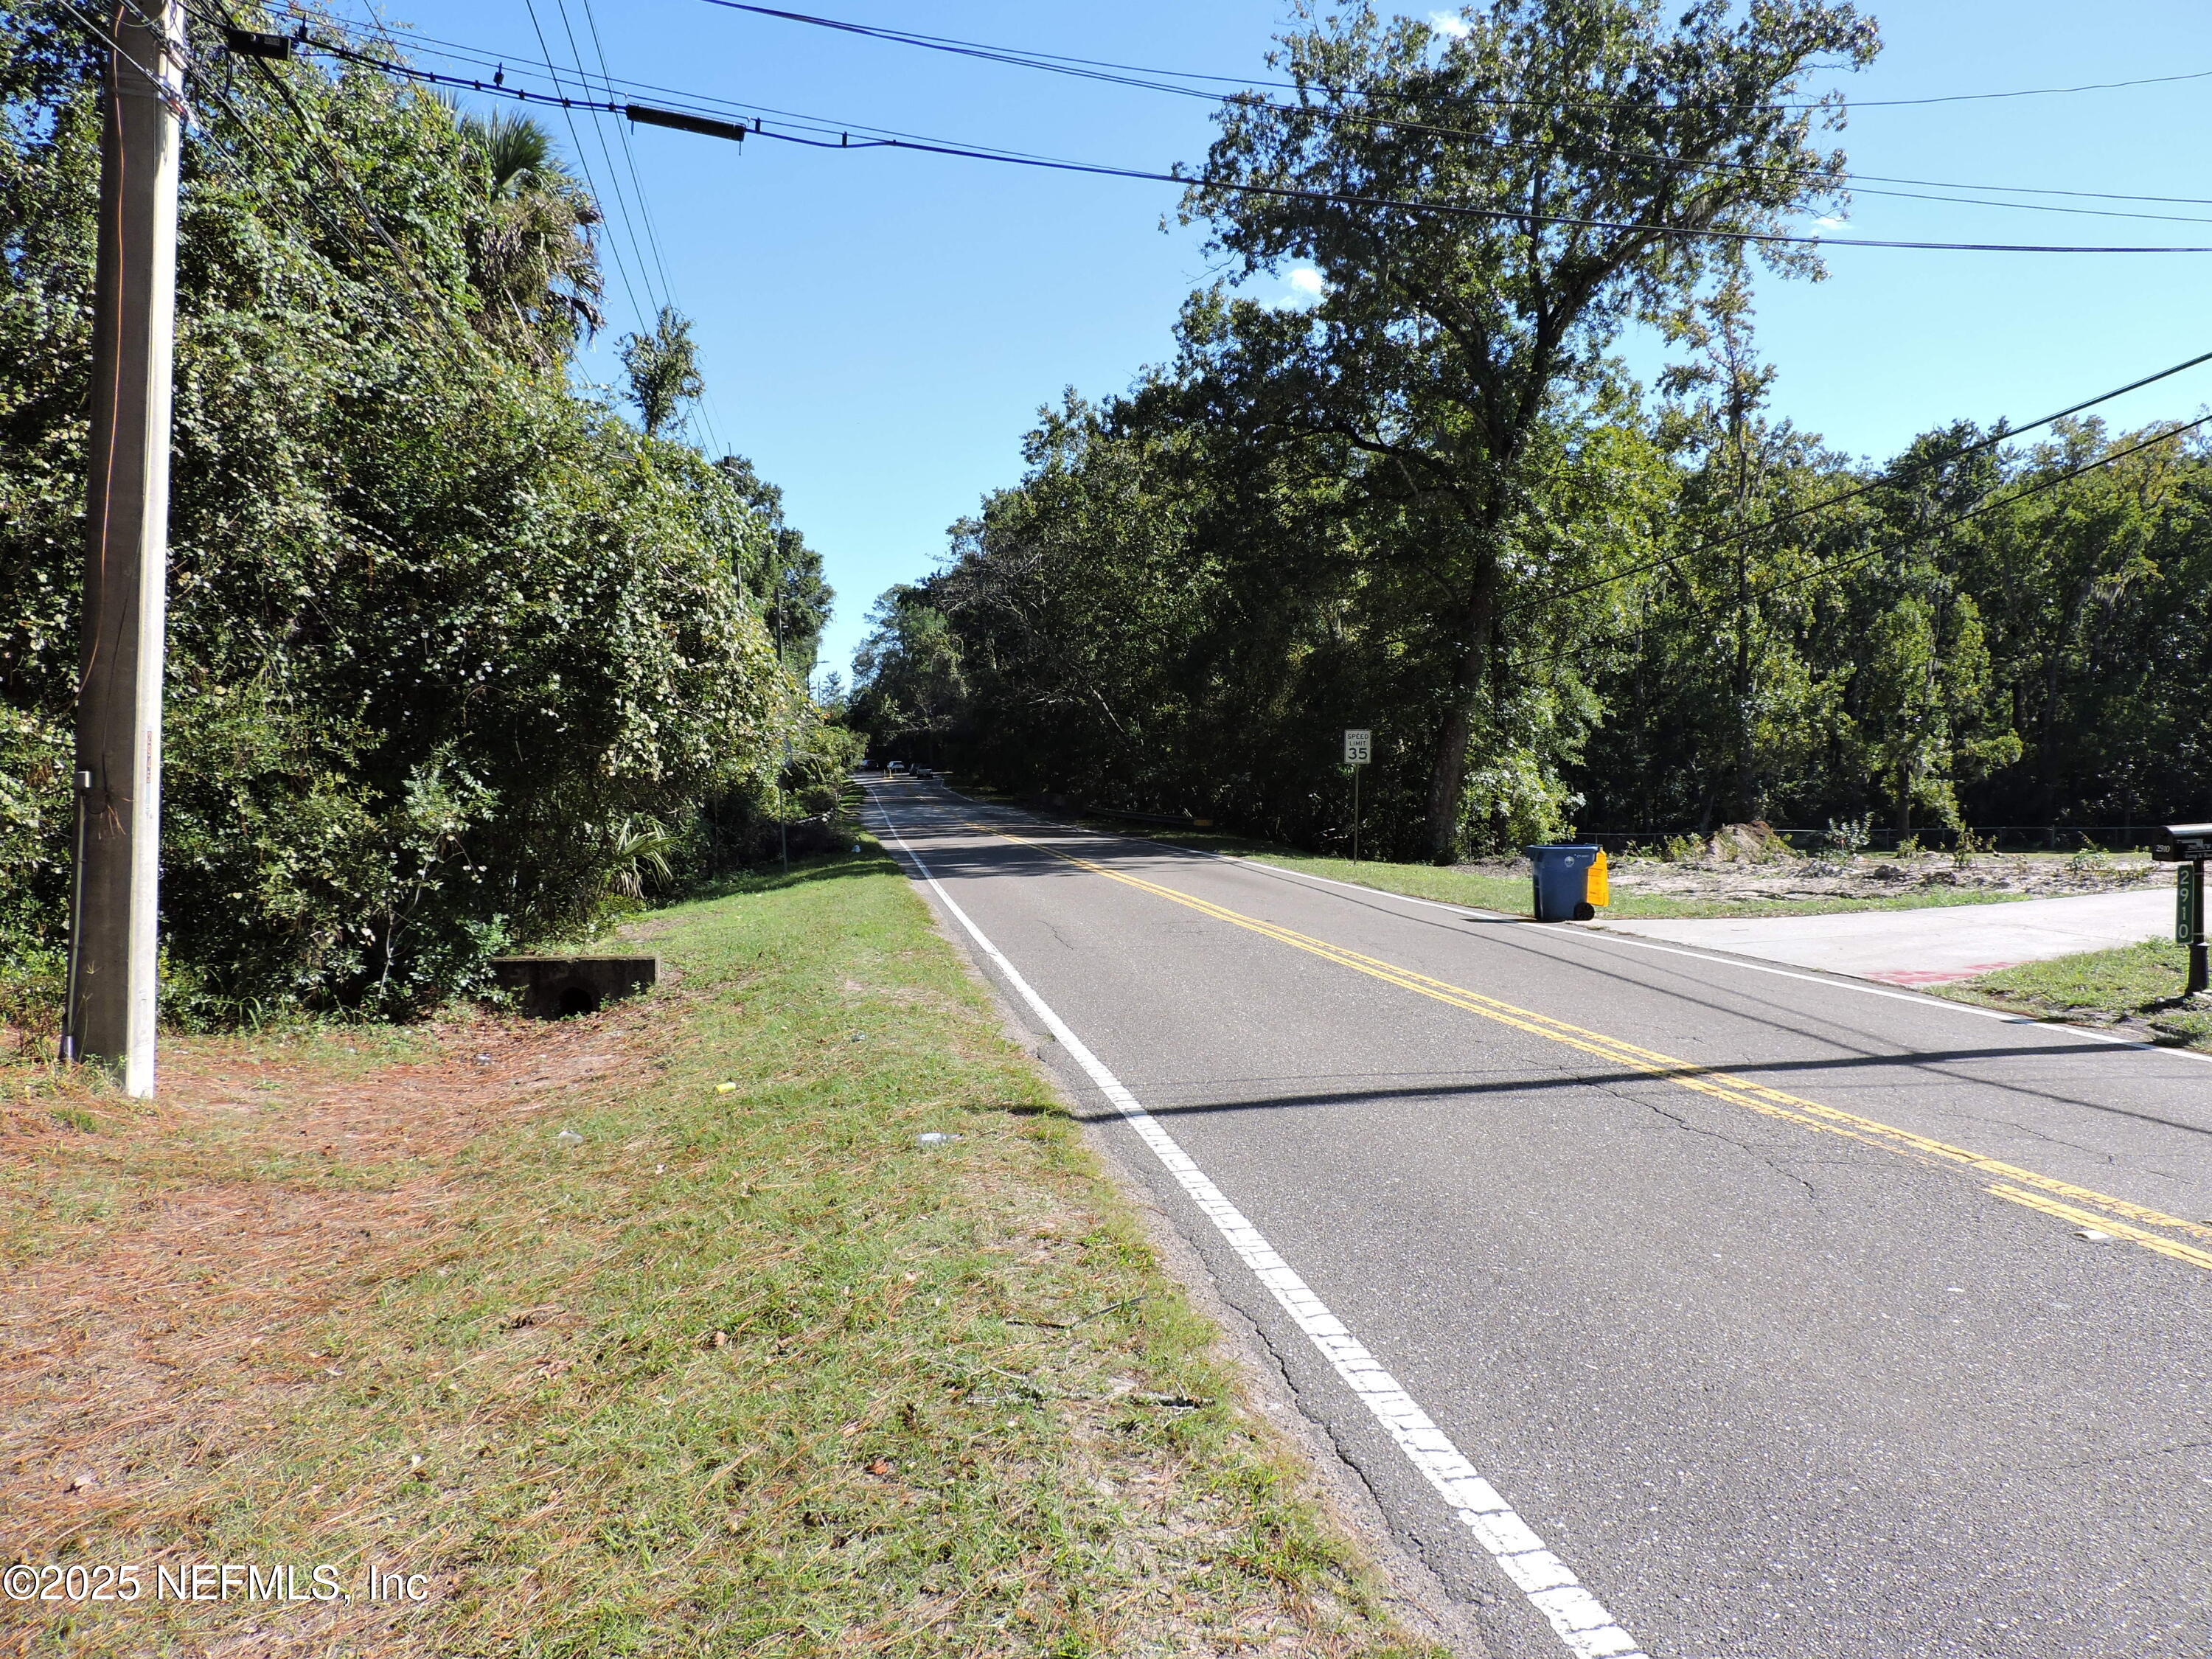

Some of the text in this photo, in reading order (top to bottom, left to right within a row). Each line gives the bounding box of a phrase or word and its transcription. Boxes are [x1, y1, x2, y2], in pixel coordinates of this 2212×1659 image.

[1348, 748, 1368, 759] 35
[2156, 844, 2171, 853] 2910
[2178, 869, 2190, 939] 2910
